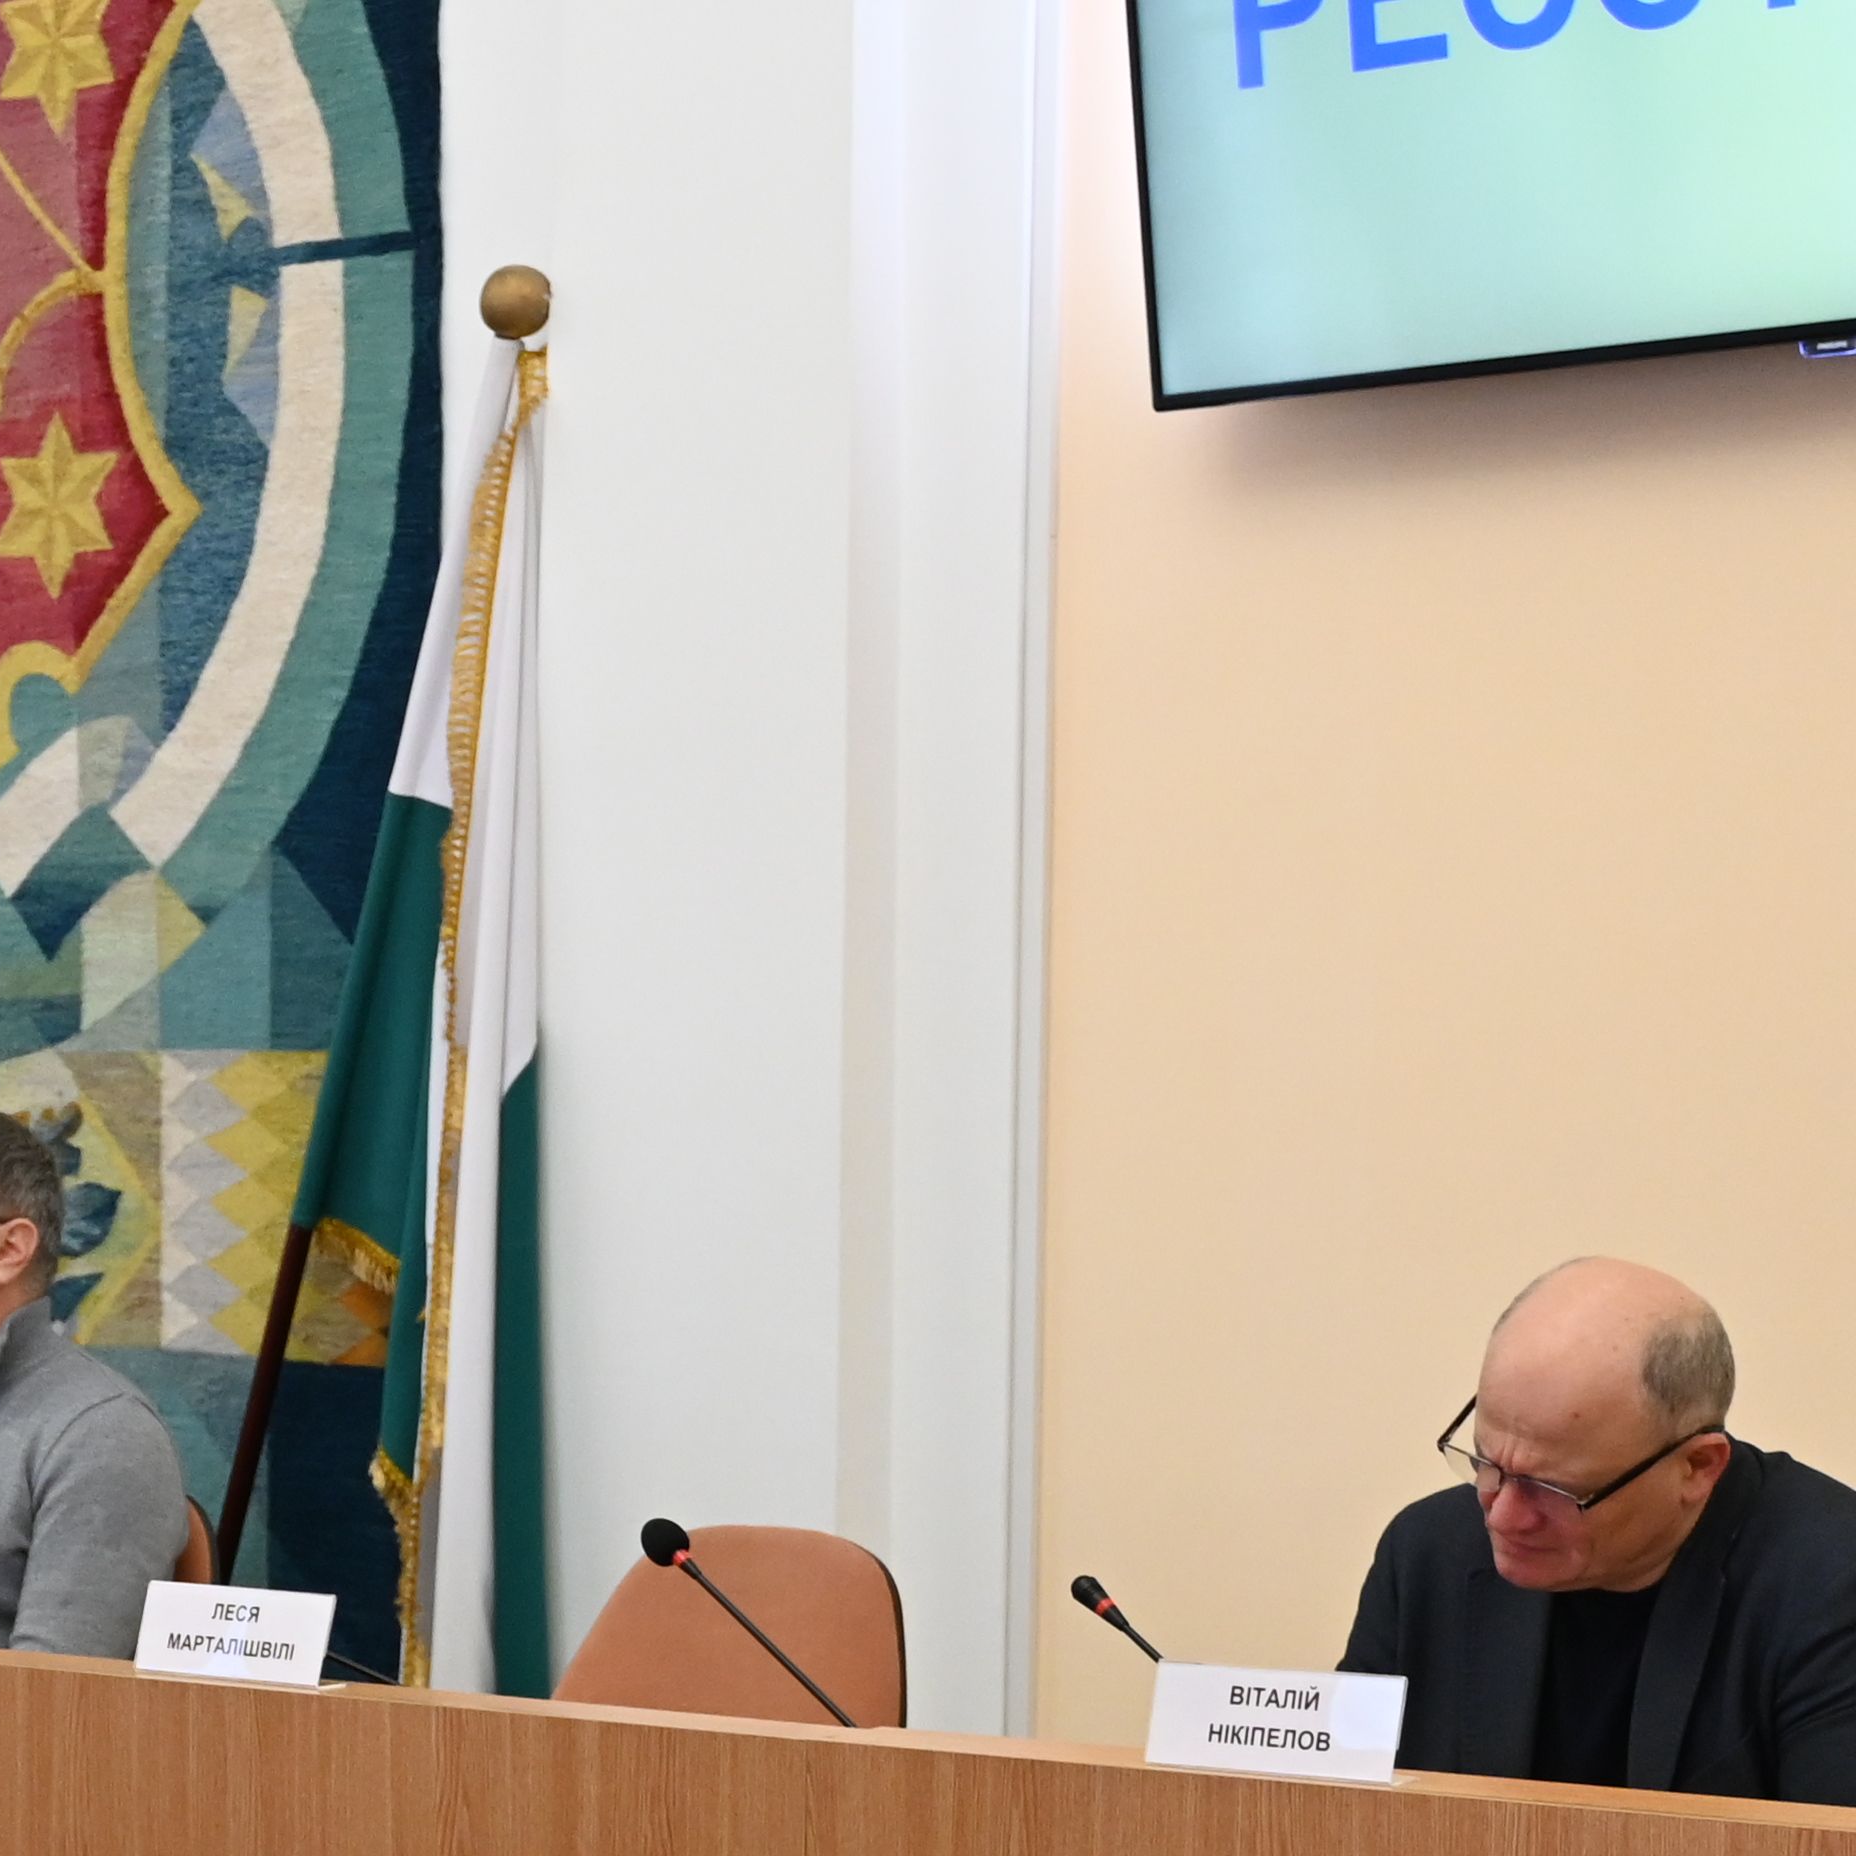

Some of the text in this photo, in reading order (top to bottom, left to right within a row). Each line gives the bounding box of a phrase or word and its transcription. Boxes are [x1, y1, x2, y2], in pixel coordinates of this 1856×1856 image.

[211, 1602, 261, 1623] ЛЕСЯ
[167, 1632, 296, 1661] МАРТАЛІШВІЛІ
[1229, 1685, 1321, 1712] ВІТАЛІЙ
[1207, 1723, 1332, 1752] НІКІПЕЛОВ
